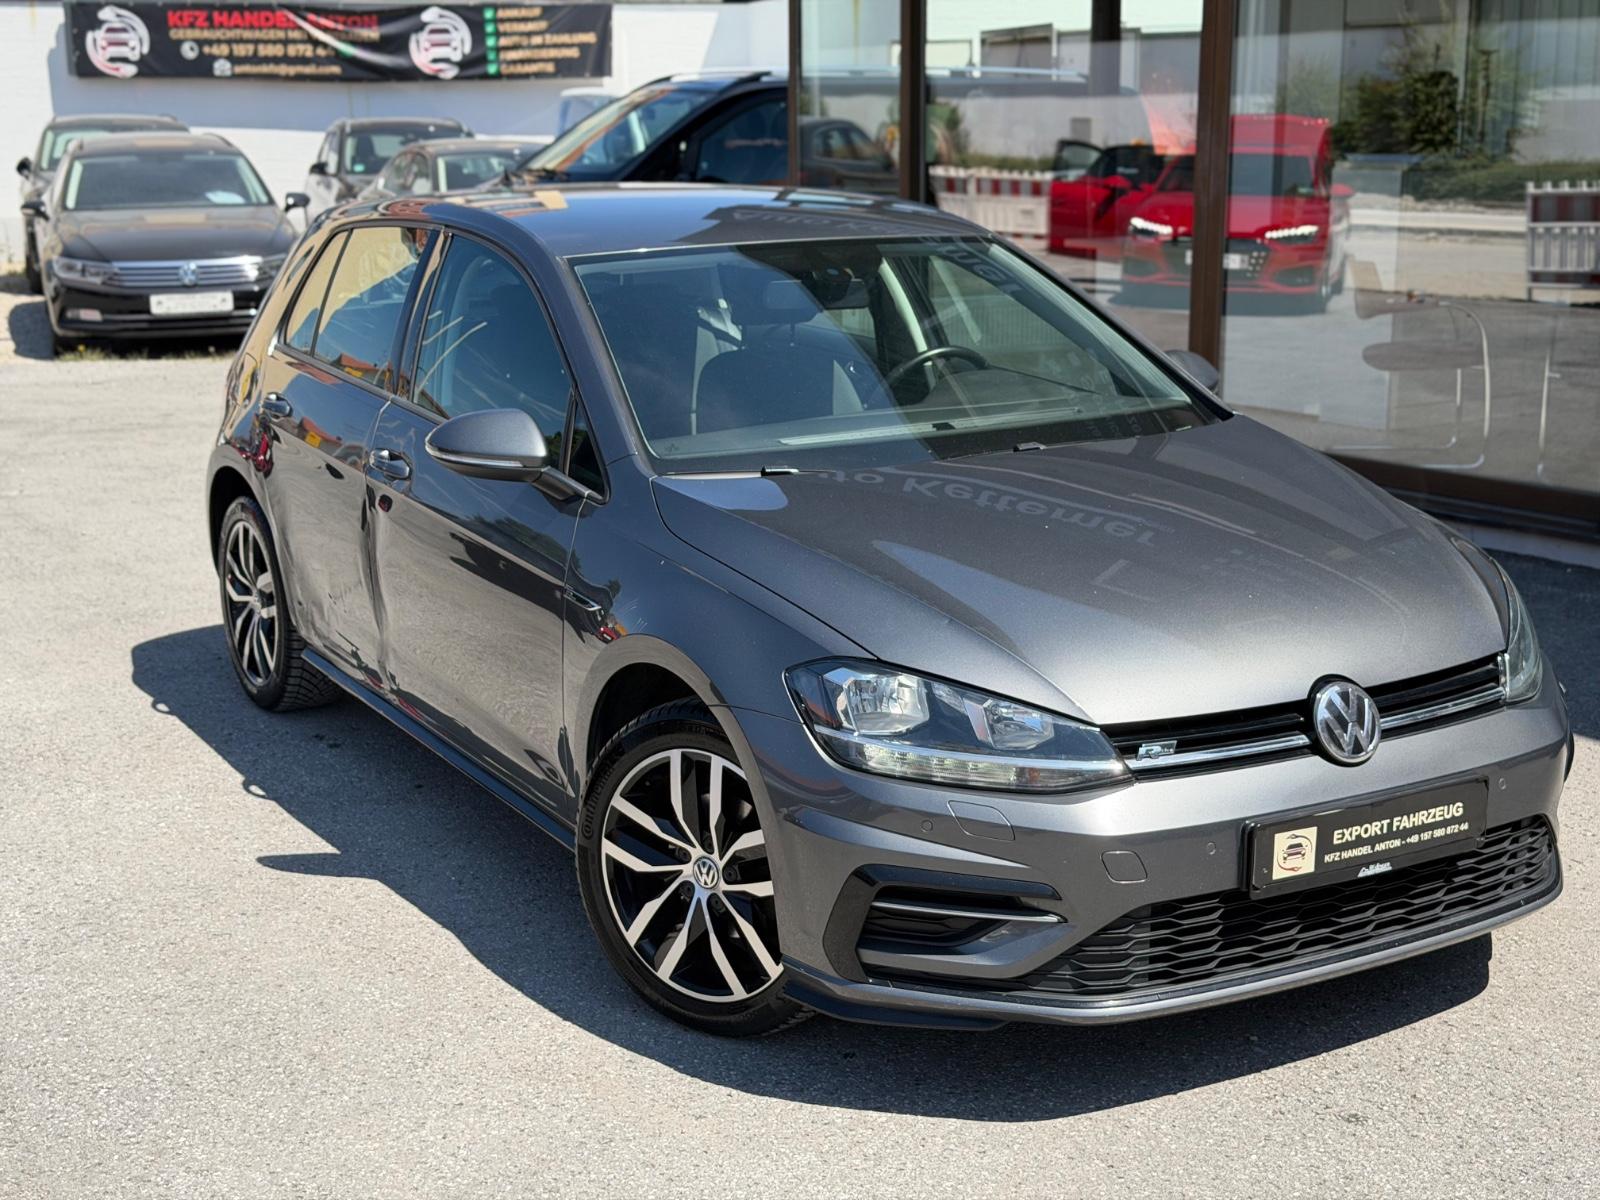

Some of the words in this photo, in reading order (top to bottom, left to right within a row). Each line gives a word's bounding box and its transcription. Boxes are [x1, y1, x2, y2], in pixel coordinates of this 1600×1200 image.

[167, 10, 209, 28] KFZ
[1333, 819, 1391, 845] EXPORT
[1393, 802, 1463, 832] FAHRZEUG
[1324, 852, 1341, 863] KFZ
[1341, 845, 1373, 860] HANDEL
[1374, 838, 1401, 852] ANTON
[1420, 830, 1432, 841] 157
